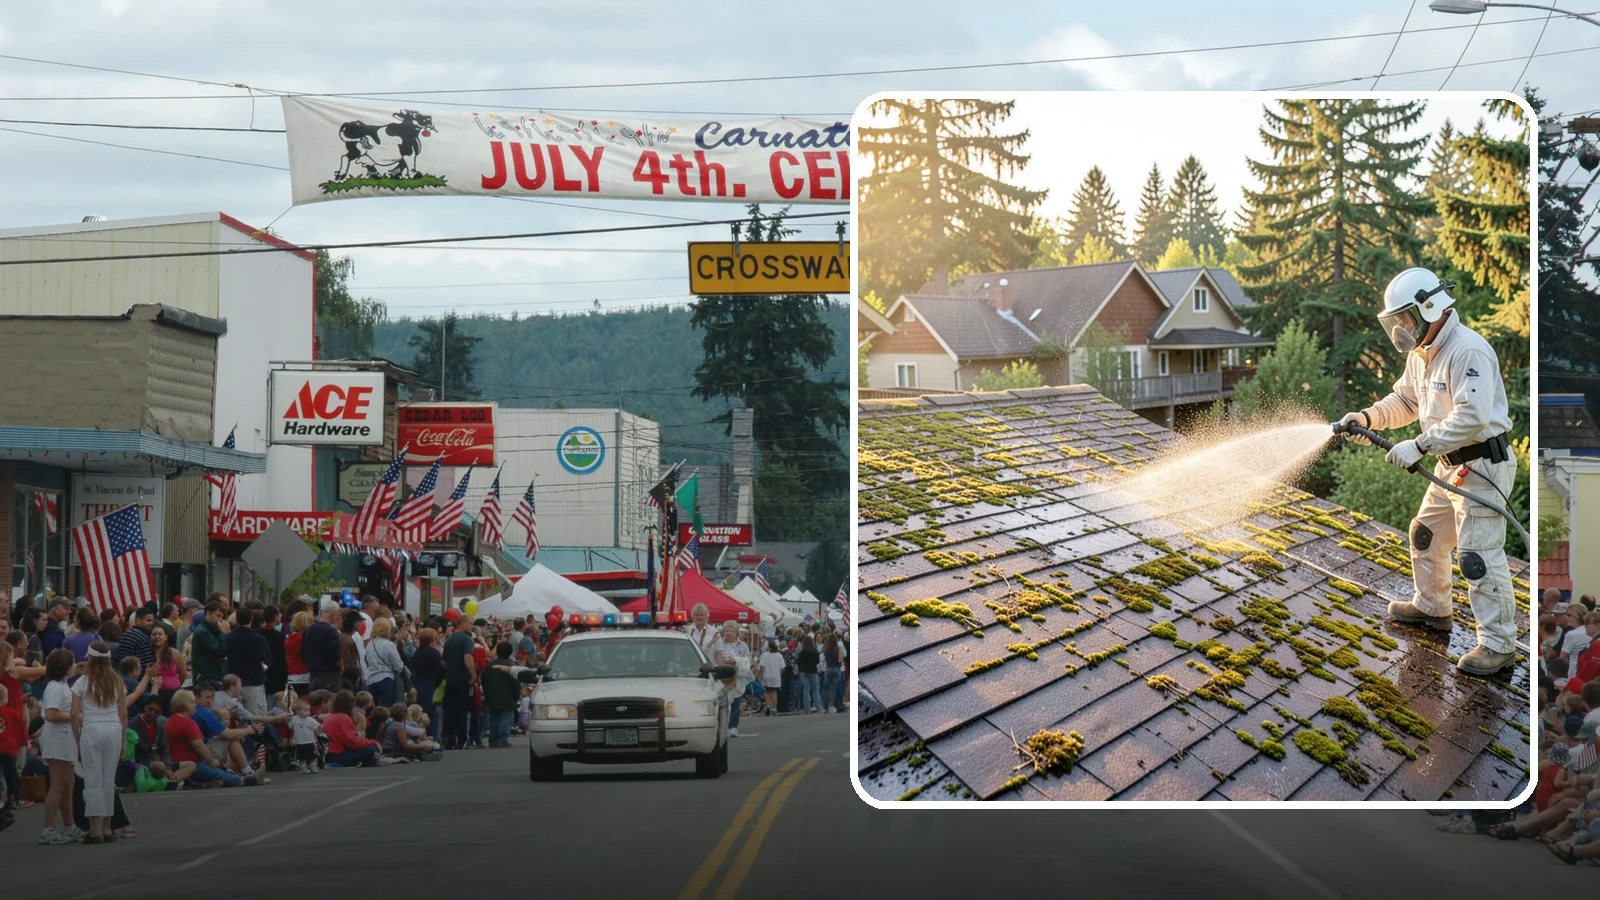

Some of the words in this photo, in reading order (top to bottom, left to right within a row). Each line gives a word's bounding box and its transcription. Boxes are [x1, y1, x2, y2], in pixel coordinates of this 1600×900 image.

[481, 141, 605, 193] JULY
[632, 150, 746, 198] 4th.
[697, 254, 850, 281] CROSSWA
[283, 380, 373, 420] ACE
[406, 409, 452, 423] CEDAR
[461, 409, 485, 423] LOG
[283, 421, 370, 436] Hardware
[416, 428, 477, 447] Coca-Cola
[354, 467, 386, 481] Simpl
[83, 485, 94, 494] St.
[96, 485, 124, 495] Vincent
[126, 486, 136, 494] de
[138, 486, 155, 495] Paul
[212, 516, 331, 536] HARDARE
[688, 526, 741, 535] CRNATION
[699, 535, 730, 543] GLASS
